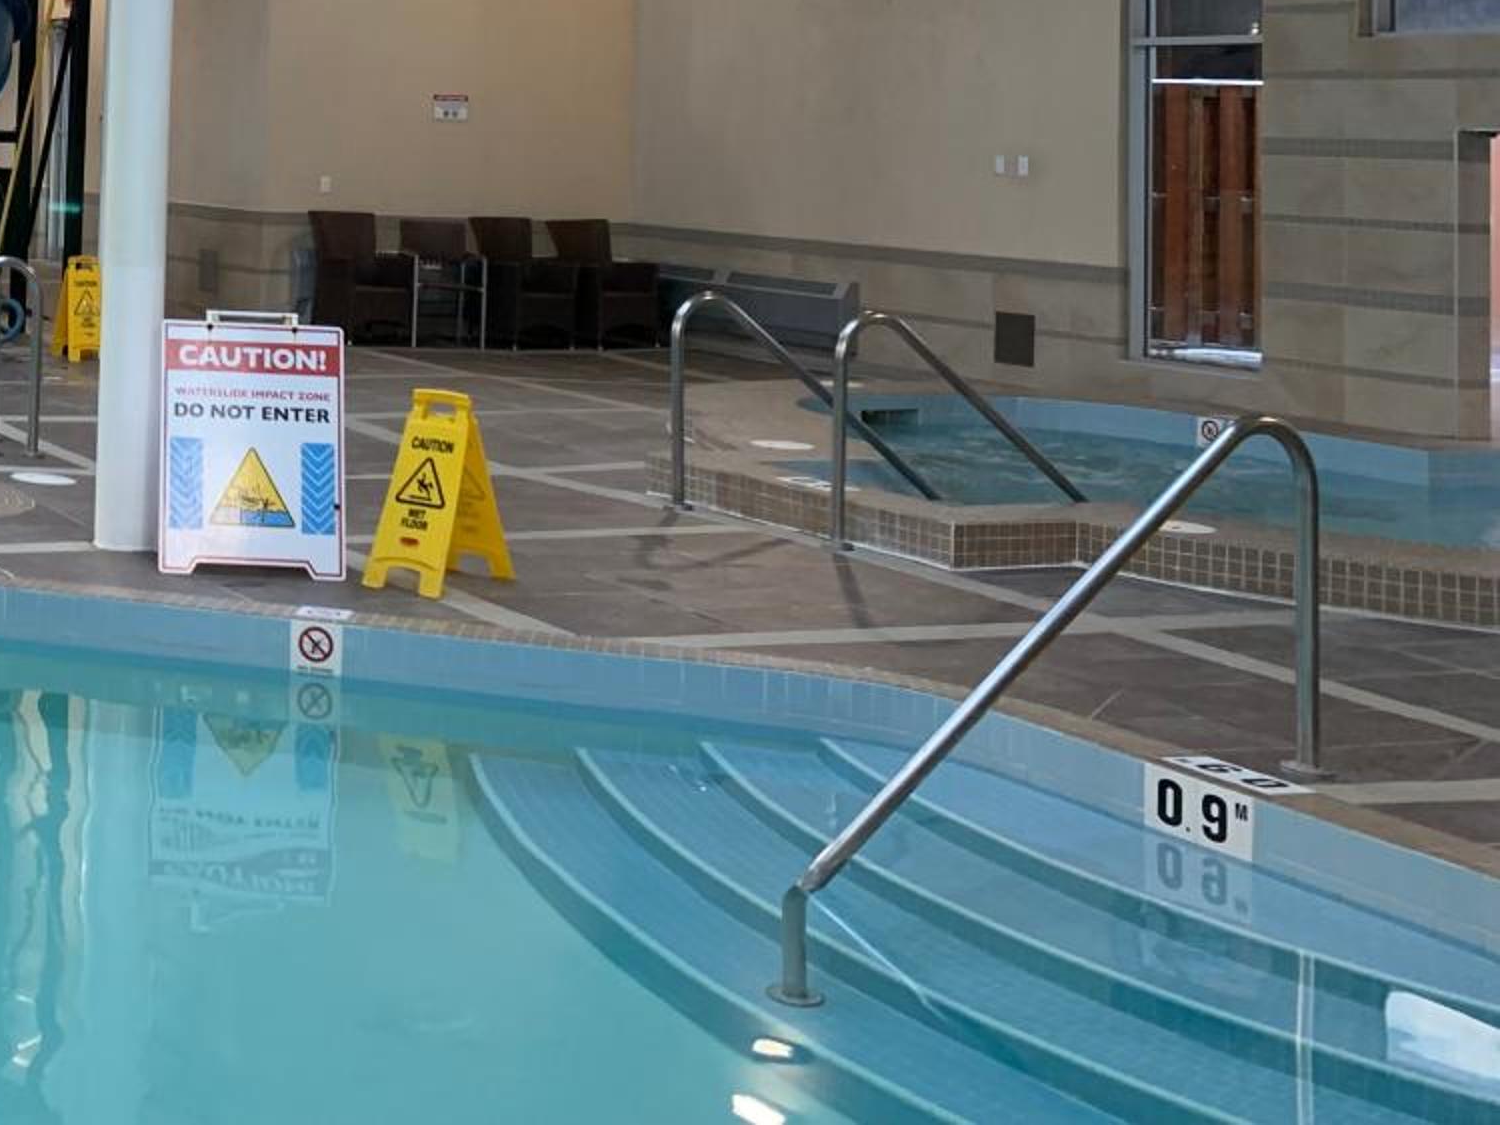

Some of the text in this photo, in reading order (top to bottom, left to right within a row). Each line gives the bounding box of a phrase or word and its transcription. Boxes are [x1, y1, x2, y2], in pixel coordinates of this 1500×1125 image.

[179, 344, 327, 371] CAUTION!
[251, 389, 295, 401] IMPACT
[299, 391, 331, 402] ZONE
[174, 402, 331, 424] DO NOT ENTER
[411, 435, 454, 454] CAUTION
